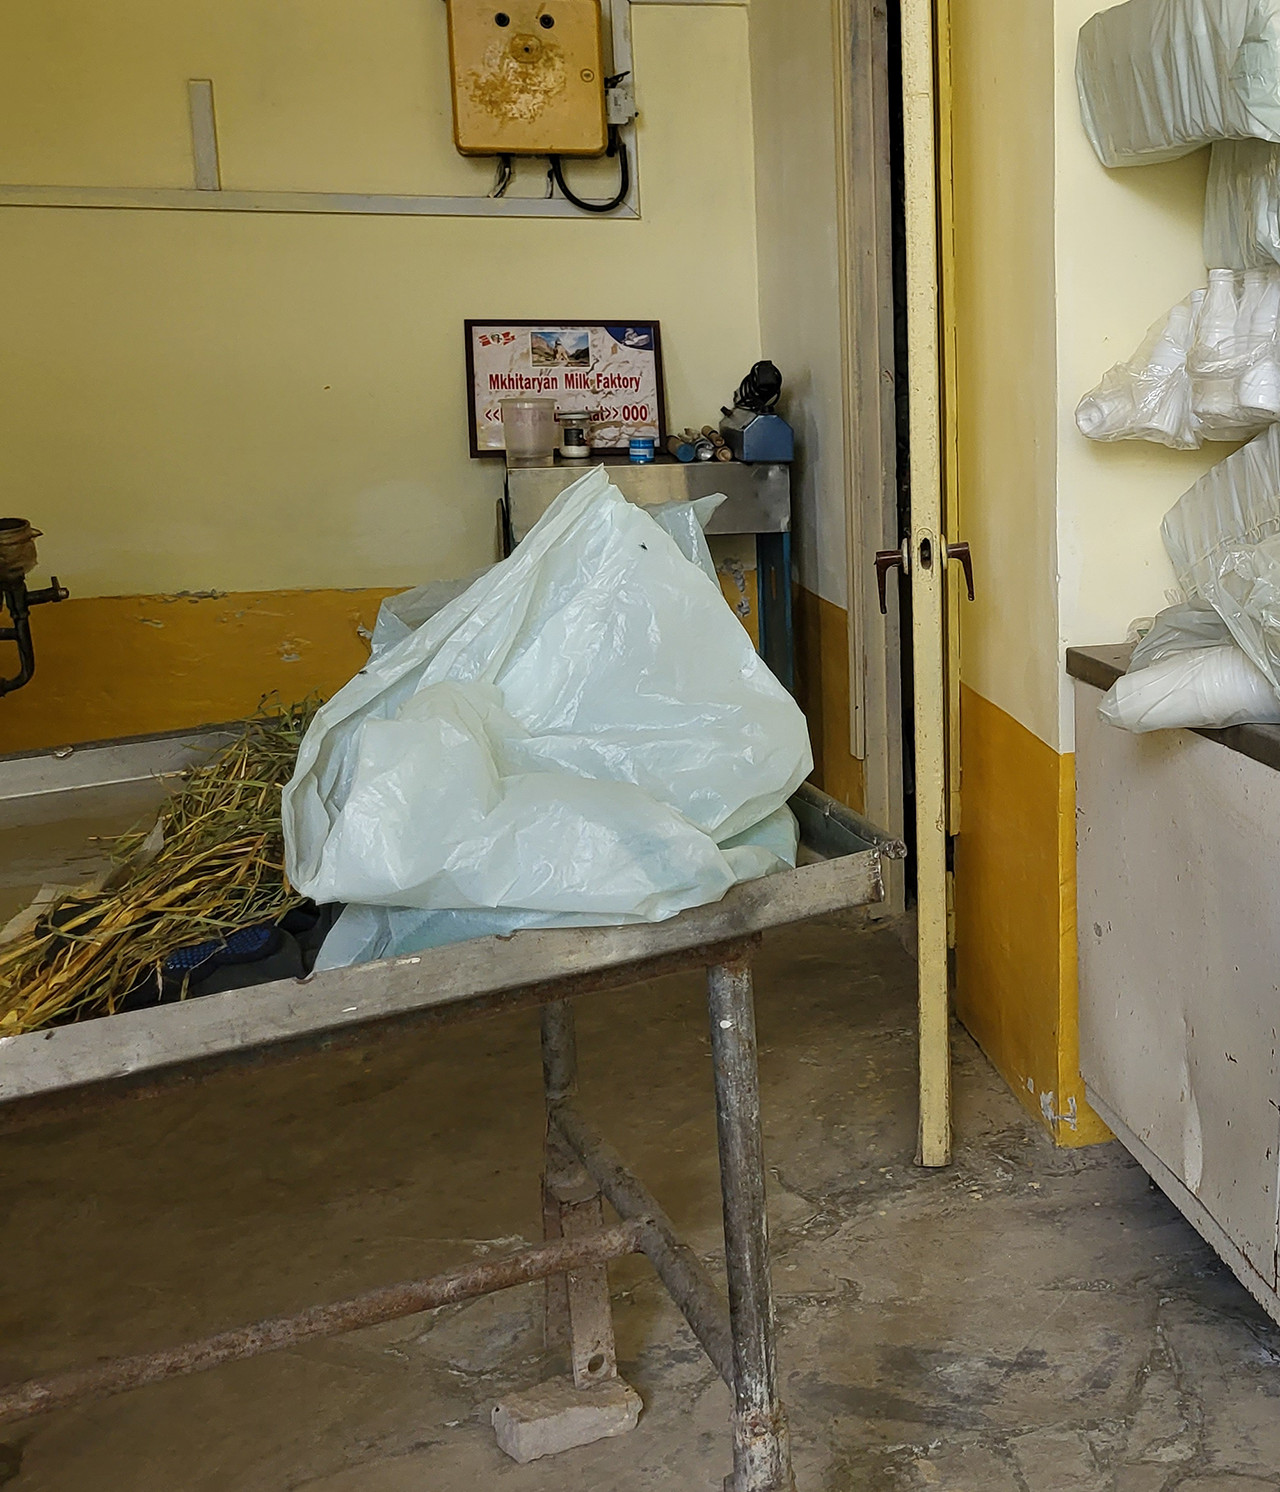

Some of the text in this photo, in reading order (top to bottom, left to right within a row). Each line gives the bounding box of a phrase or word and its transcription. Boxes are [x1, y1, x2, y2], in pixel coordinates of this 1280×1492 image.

[489, 373, 641, 393] Mkhitaryan Milk Faktory
